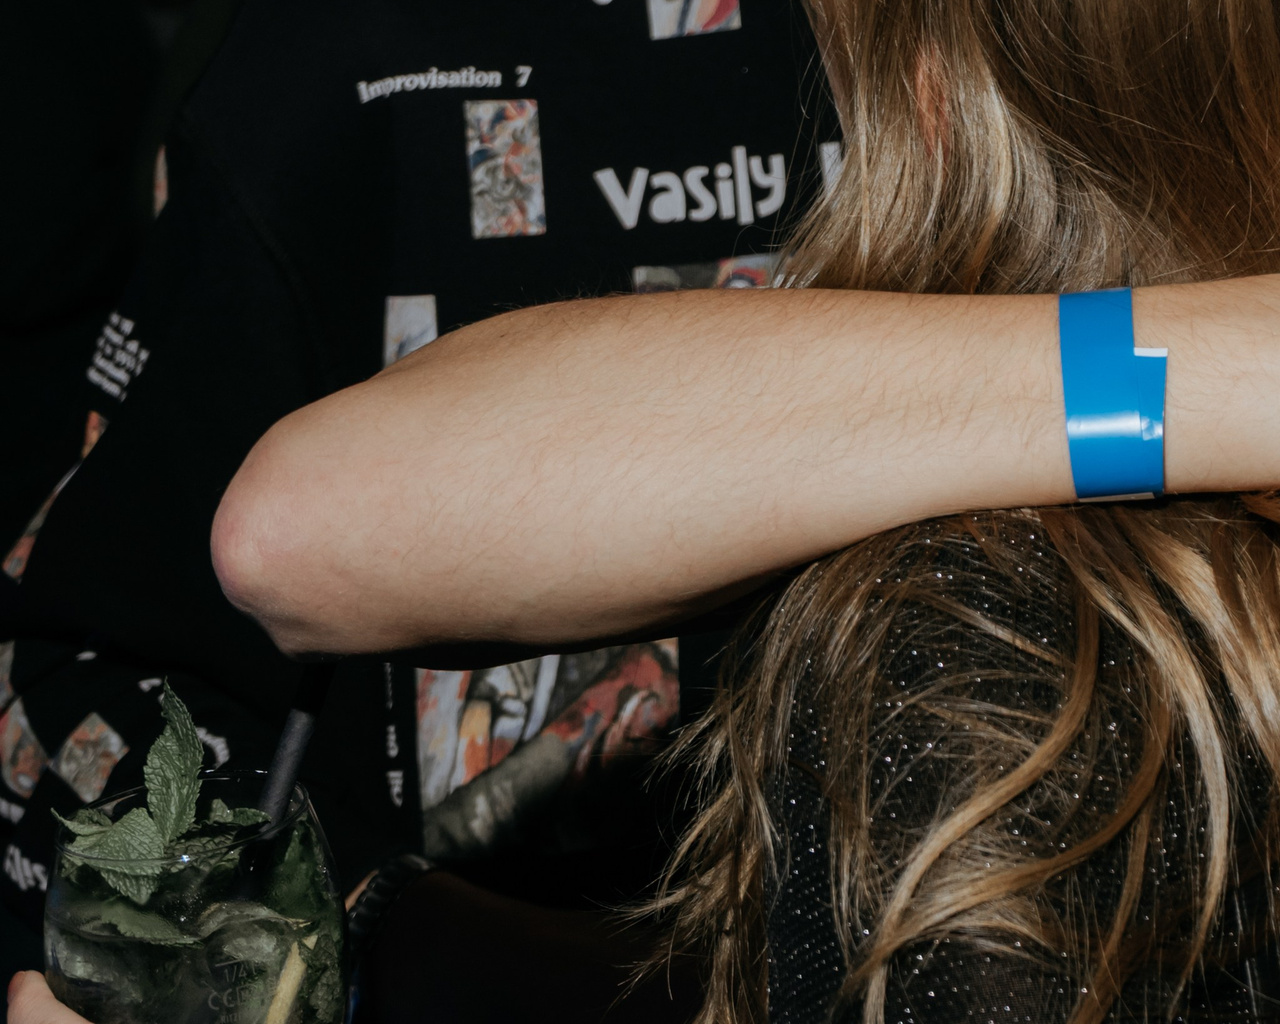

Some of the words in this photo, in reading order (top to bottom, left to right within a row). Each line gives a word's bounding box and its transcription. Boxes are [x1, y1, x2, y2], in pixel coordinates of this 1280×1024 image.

[356, 64, 503, 104] Improvisation
[514, 63, 534, 88] 7
[593, 144, 788, 231] Vasily
